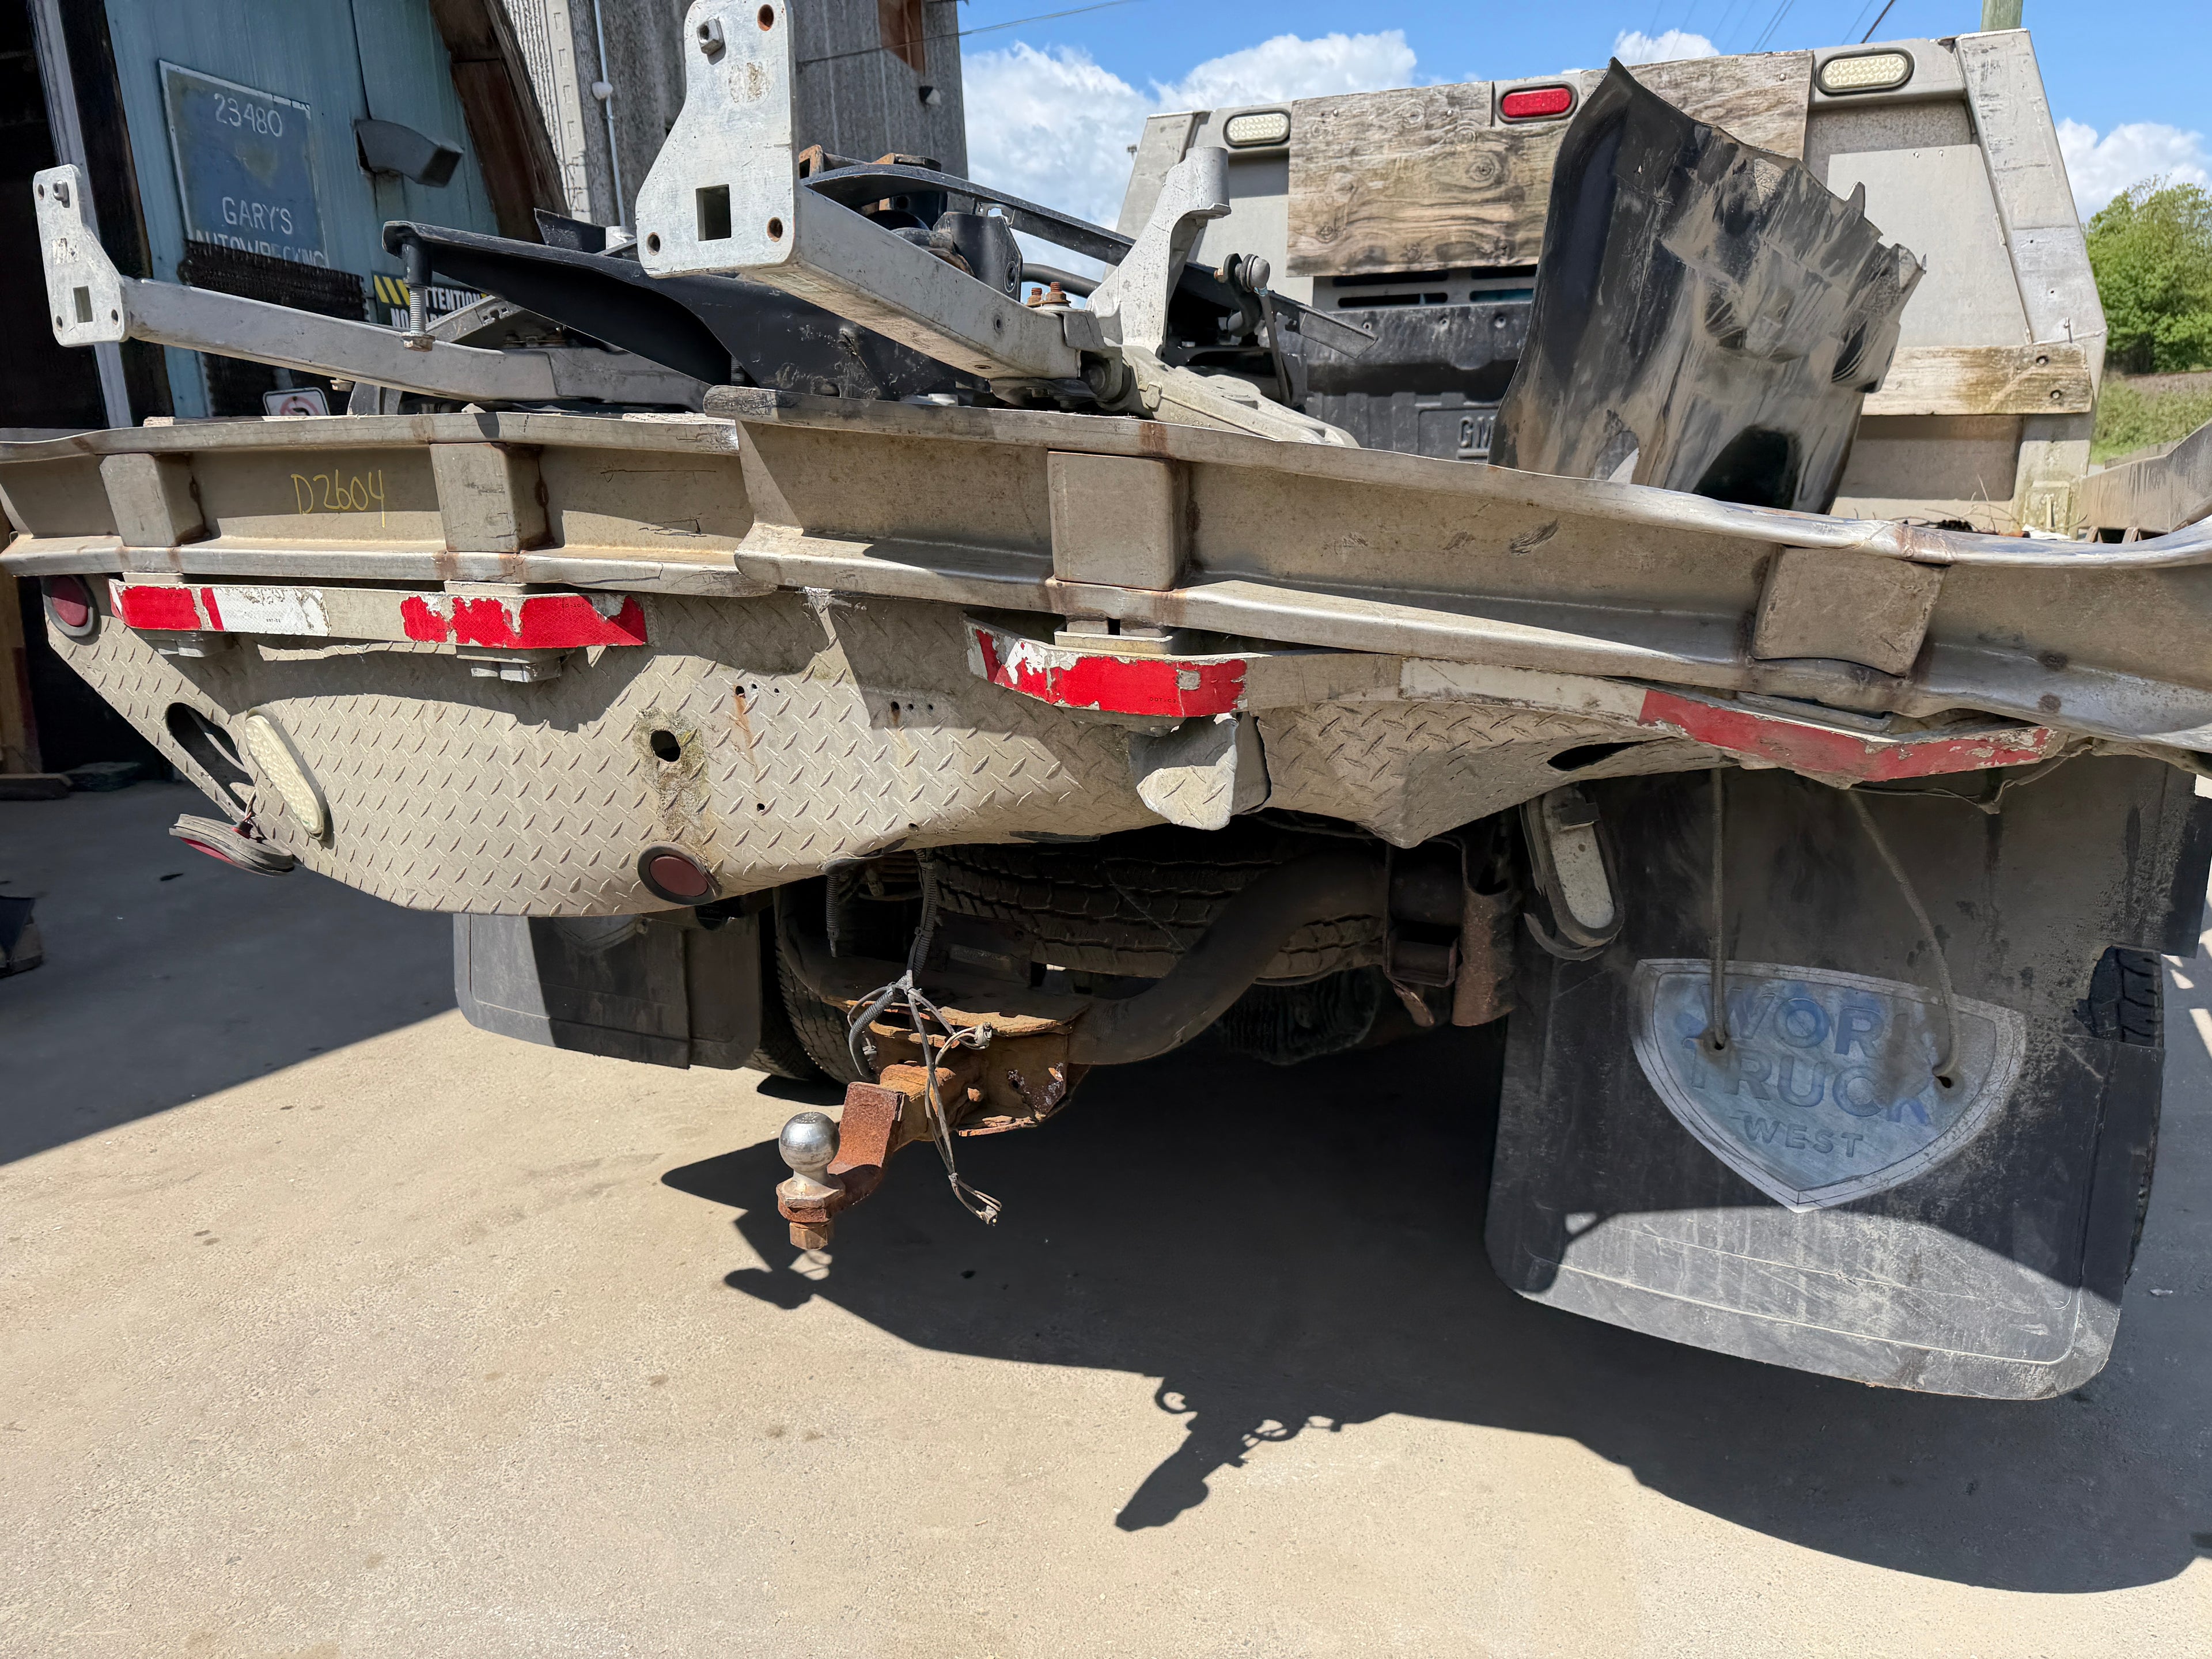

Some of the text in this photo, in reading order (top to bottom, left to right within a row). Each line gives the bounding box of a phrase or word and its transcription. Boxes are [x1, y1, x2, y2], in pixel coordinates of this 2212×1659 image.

[214, 93, 282, 137] 23480
[222, 196, 293, 234] GARY'S
[290, 469, 385, 528] D2604
[1743, 1115, 1863, 1158] WEST
